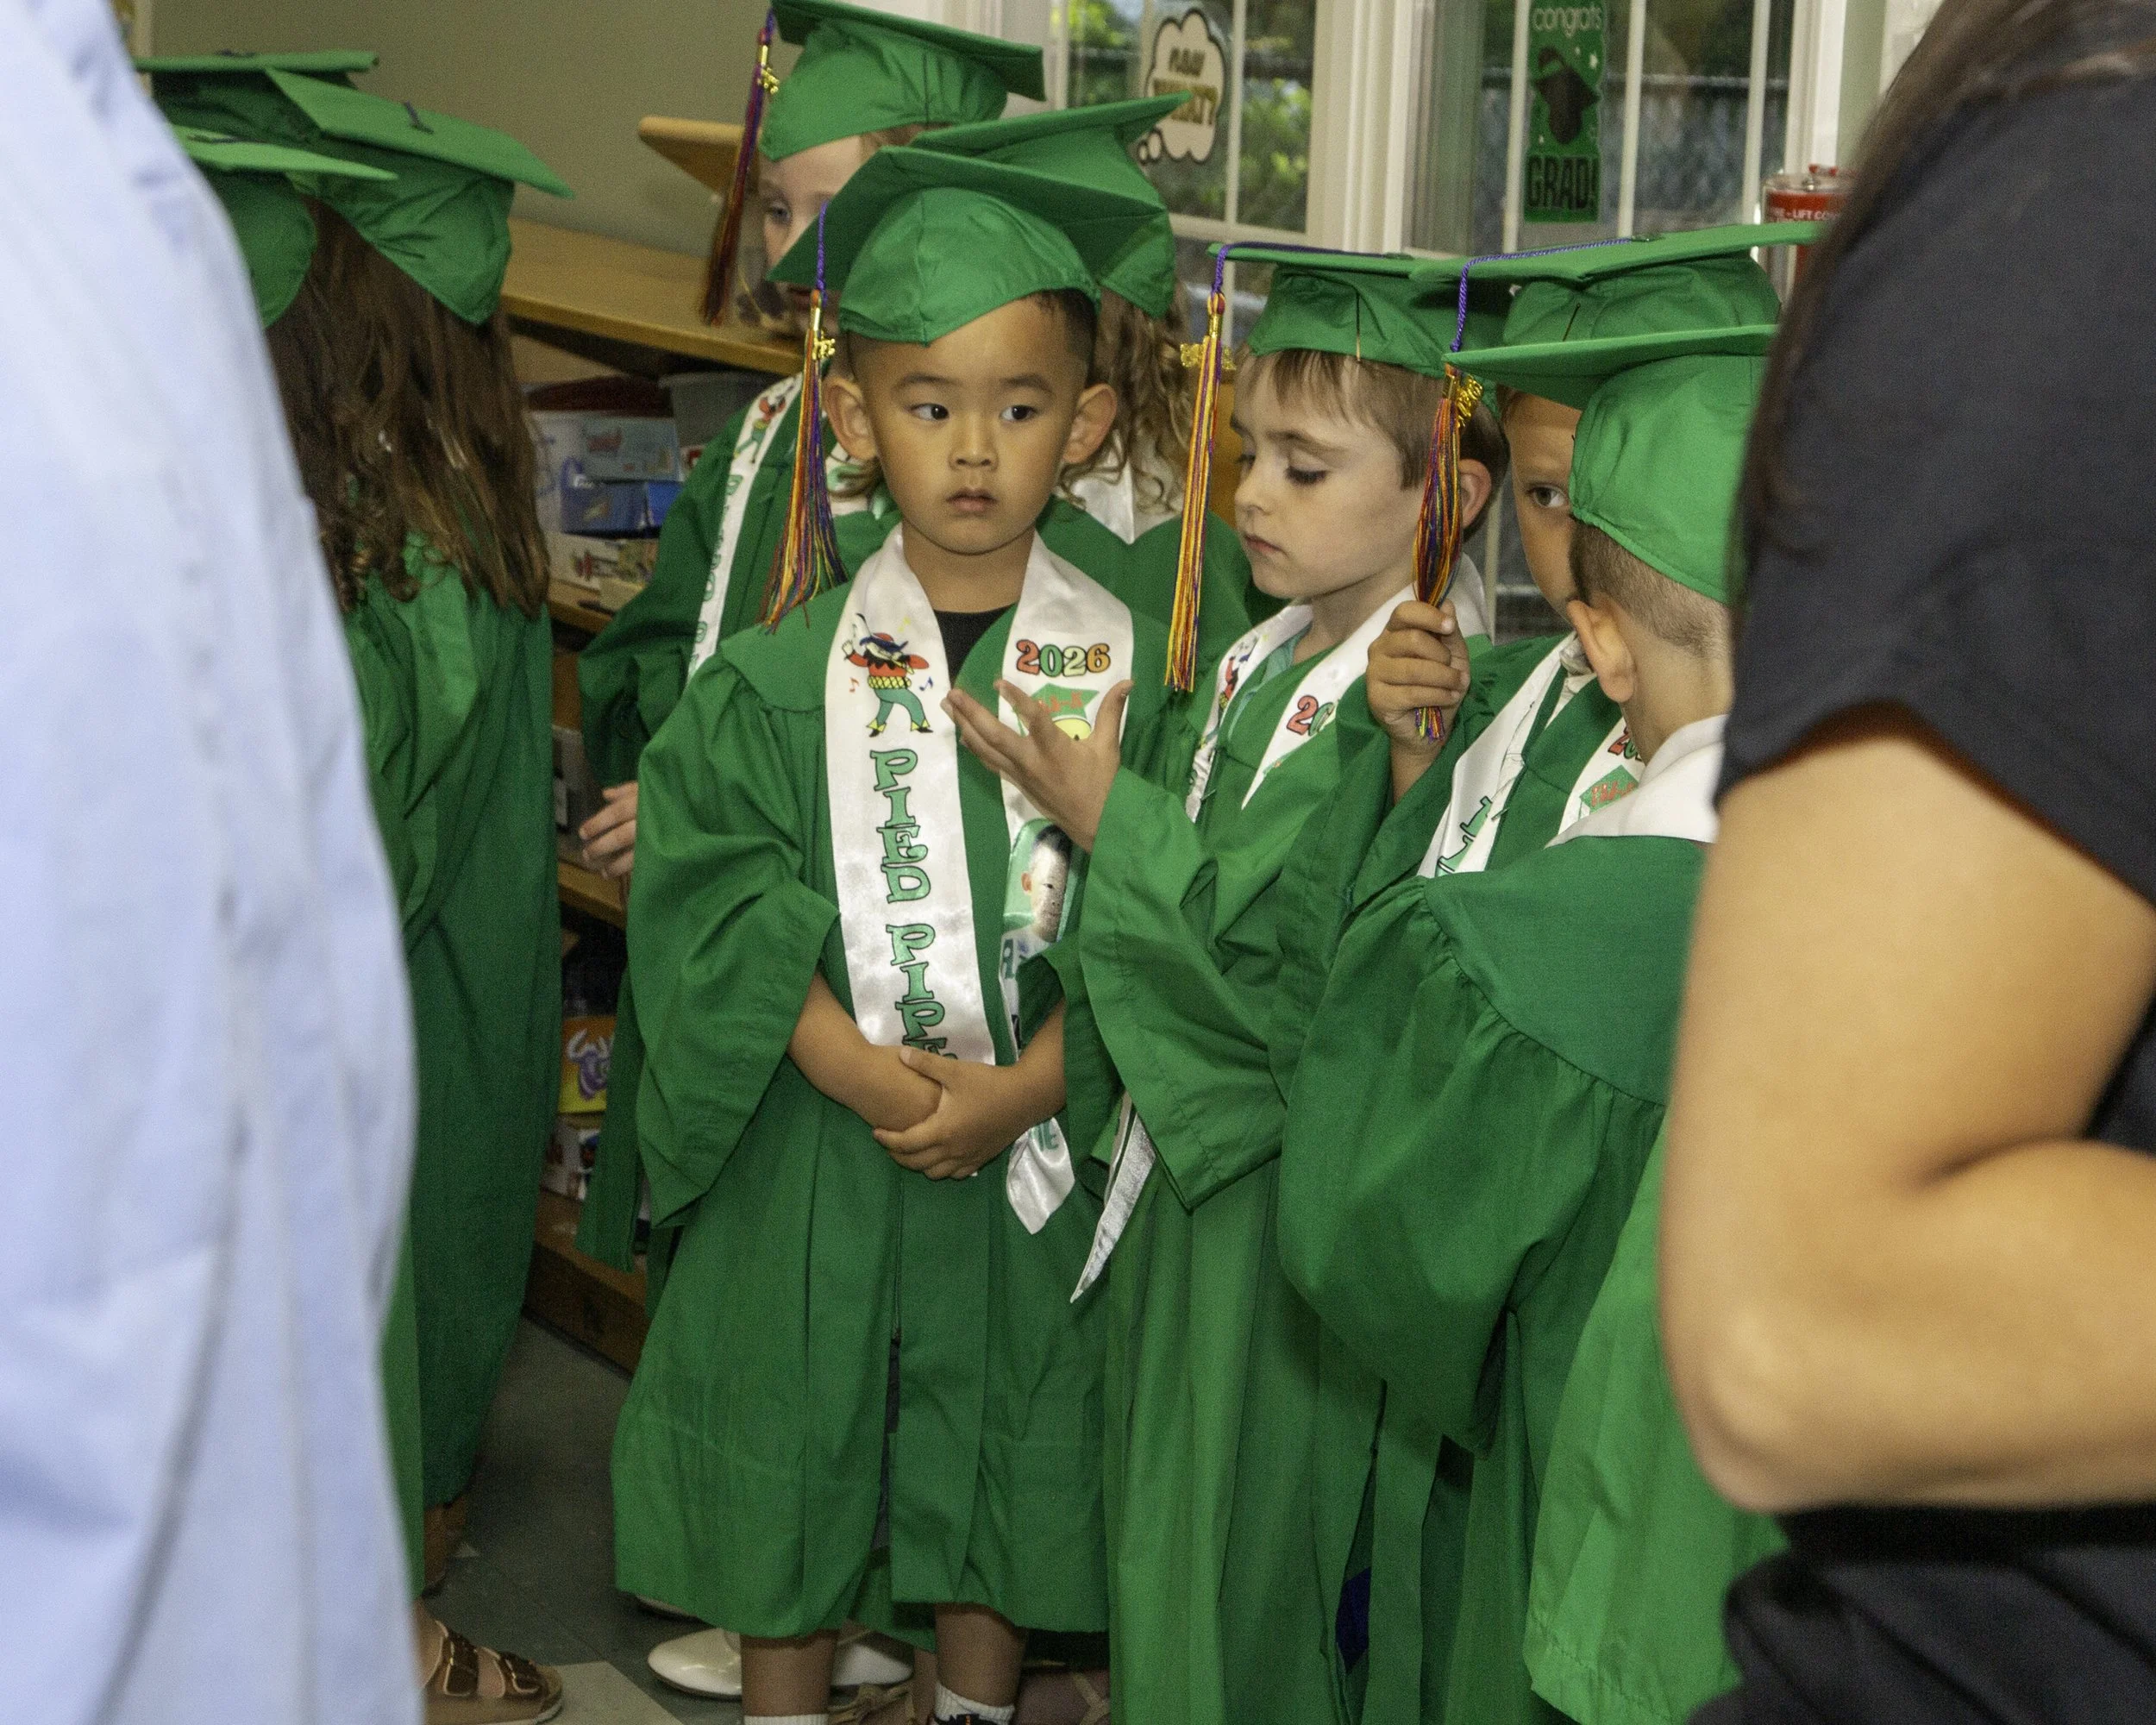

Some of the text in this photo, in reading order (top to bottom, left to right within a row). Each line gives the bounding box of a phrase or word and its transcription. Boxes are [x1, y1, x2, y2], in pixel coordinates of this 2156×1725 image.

[1526, 156, 1600, 210] GRAD!
[1016, 639, 1111, 678] 2026
[869, 748, 931, 904] PIED
